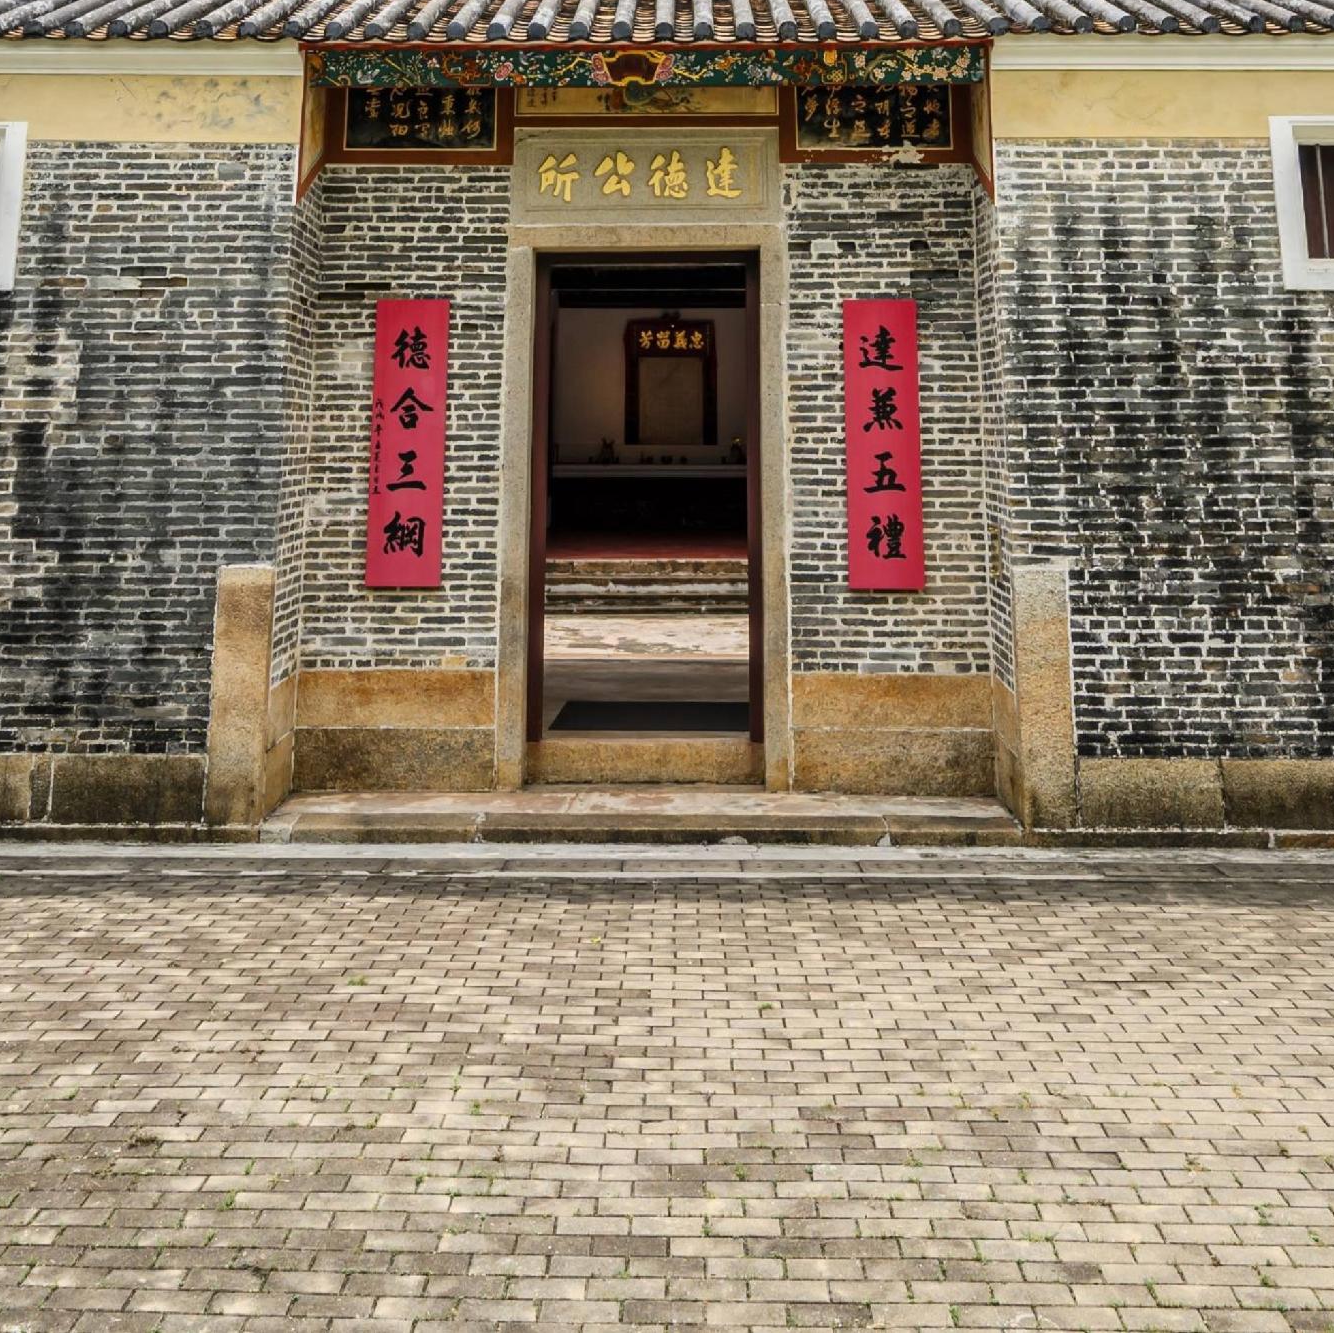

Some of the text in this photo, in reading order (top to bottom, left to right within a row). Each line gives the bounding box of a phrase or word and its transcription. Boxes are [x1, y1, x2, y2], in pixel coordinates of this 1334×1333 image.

[538, 146, 744, 203] 達德公所
[383, 326, 434, 558] 德合三綱
